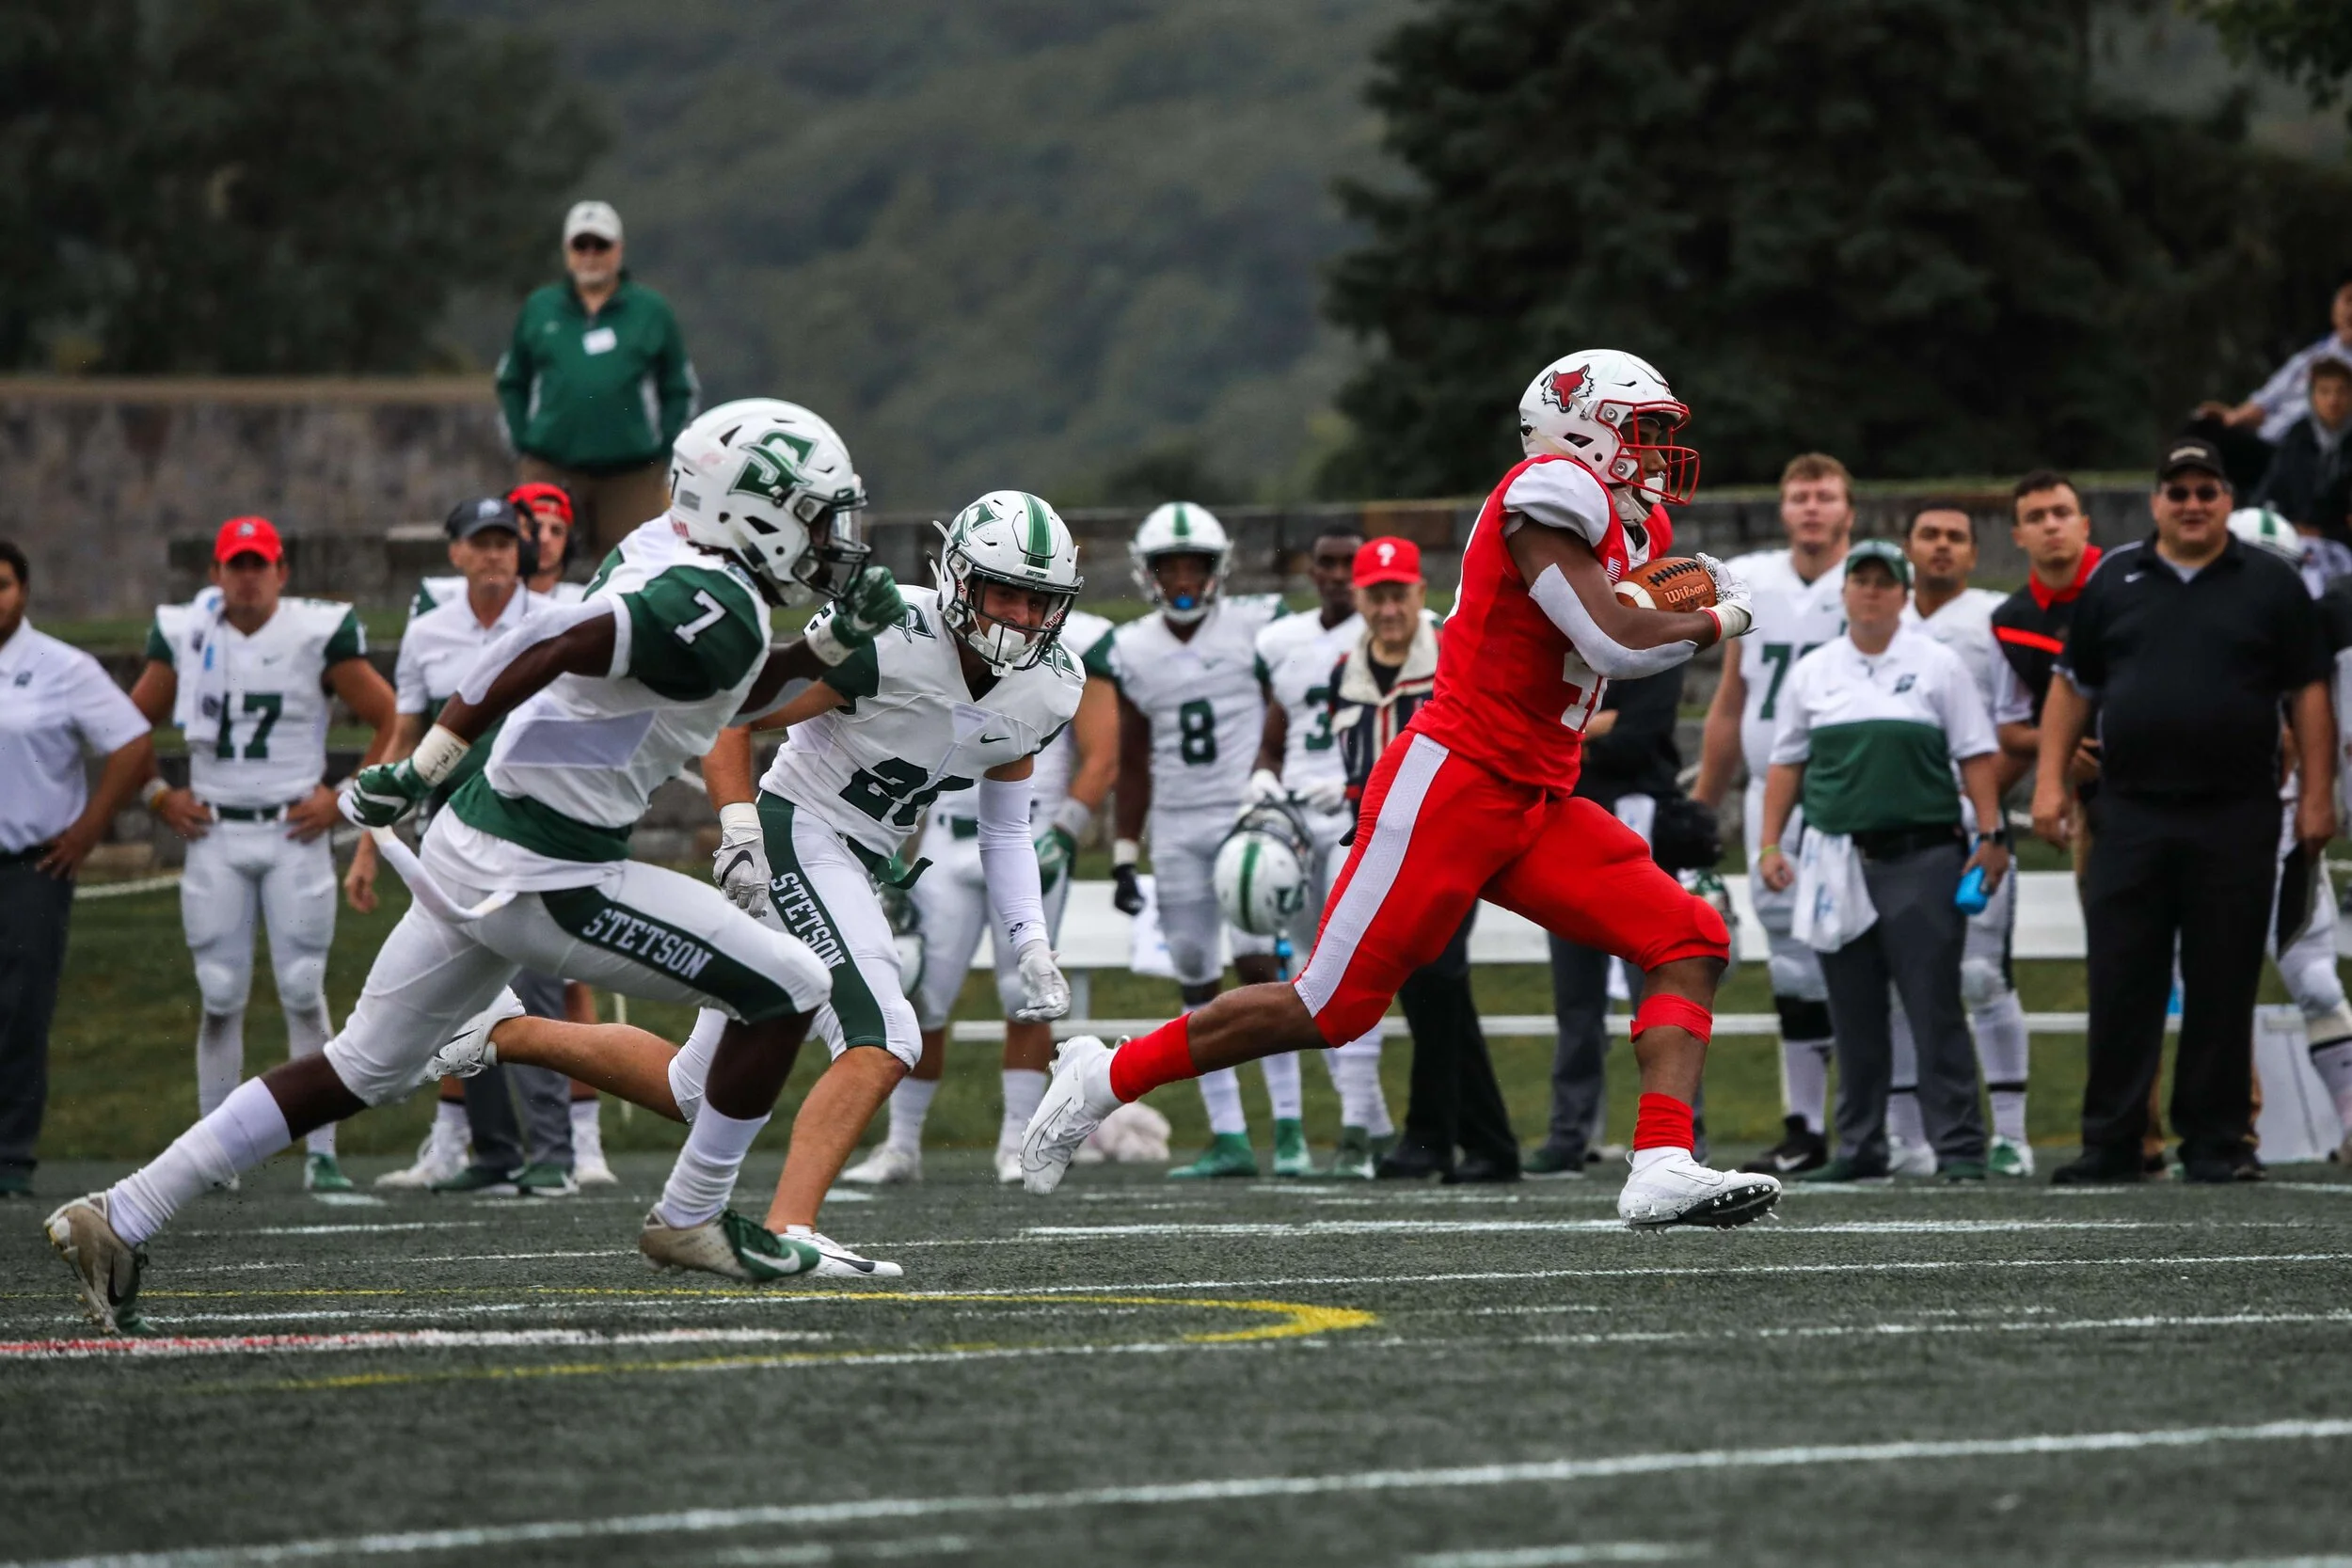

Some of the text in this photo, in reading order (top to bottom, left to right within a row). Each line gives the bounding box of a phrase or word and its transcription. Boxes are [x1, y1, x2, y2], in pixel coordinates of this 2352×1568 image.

[674, 588, 727, 645] 7
[1663, 583, 1708, 604] Wilson
[216, 690, 283, 759] 17
[1561, 649, 1608, 734] 4
[1180, 697, 1217, 767] 8
[581, 908, 714, 981] STETSON
[770, 871, 847, 971] STETSON
